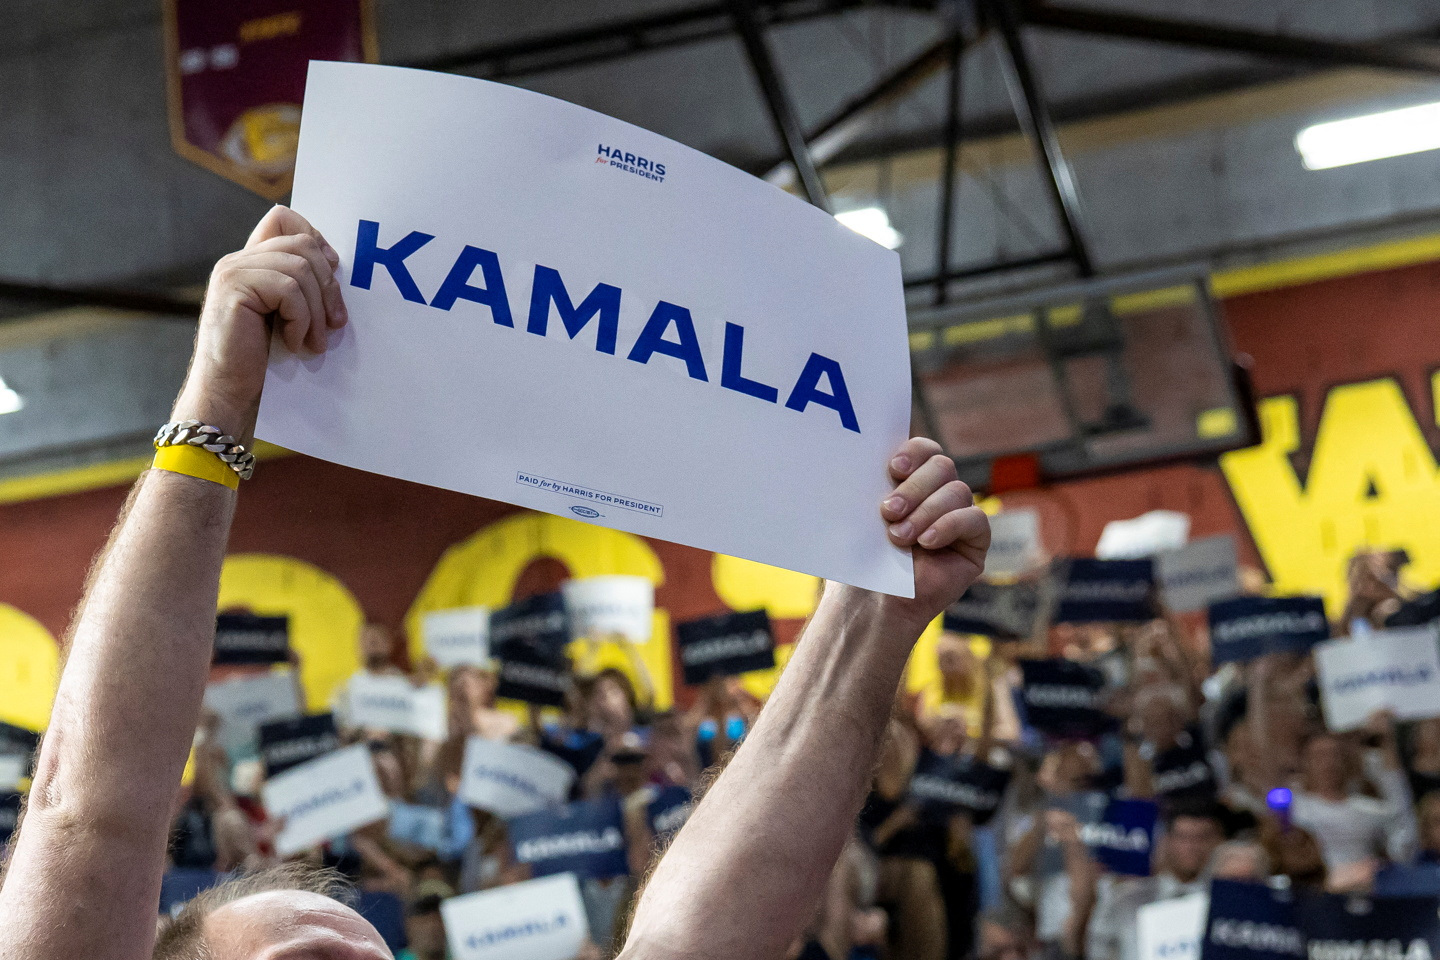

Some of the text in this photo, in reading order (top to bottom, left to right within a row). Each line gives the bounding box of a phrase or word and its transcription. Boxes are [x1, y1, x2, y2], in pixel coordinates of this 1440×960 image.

[598, 144, 665, 175] HARRIS
[610, 160, 664, 183] PRESIDENT
[350, 218, 861, 434] KAMALA
[519, 475, 661, 514] PAID for by HARRIS FOR PRESIDENT
